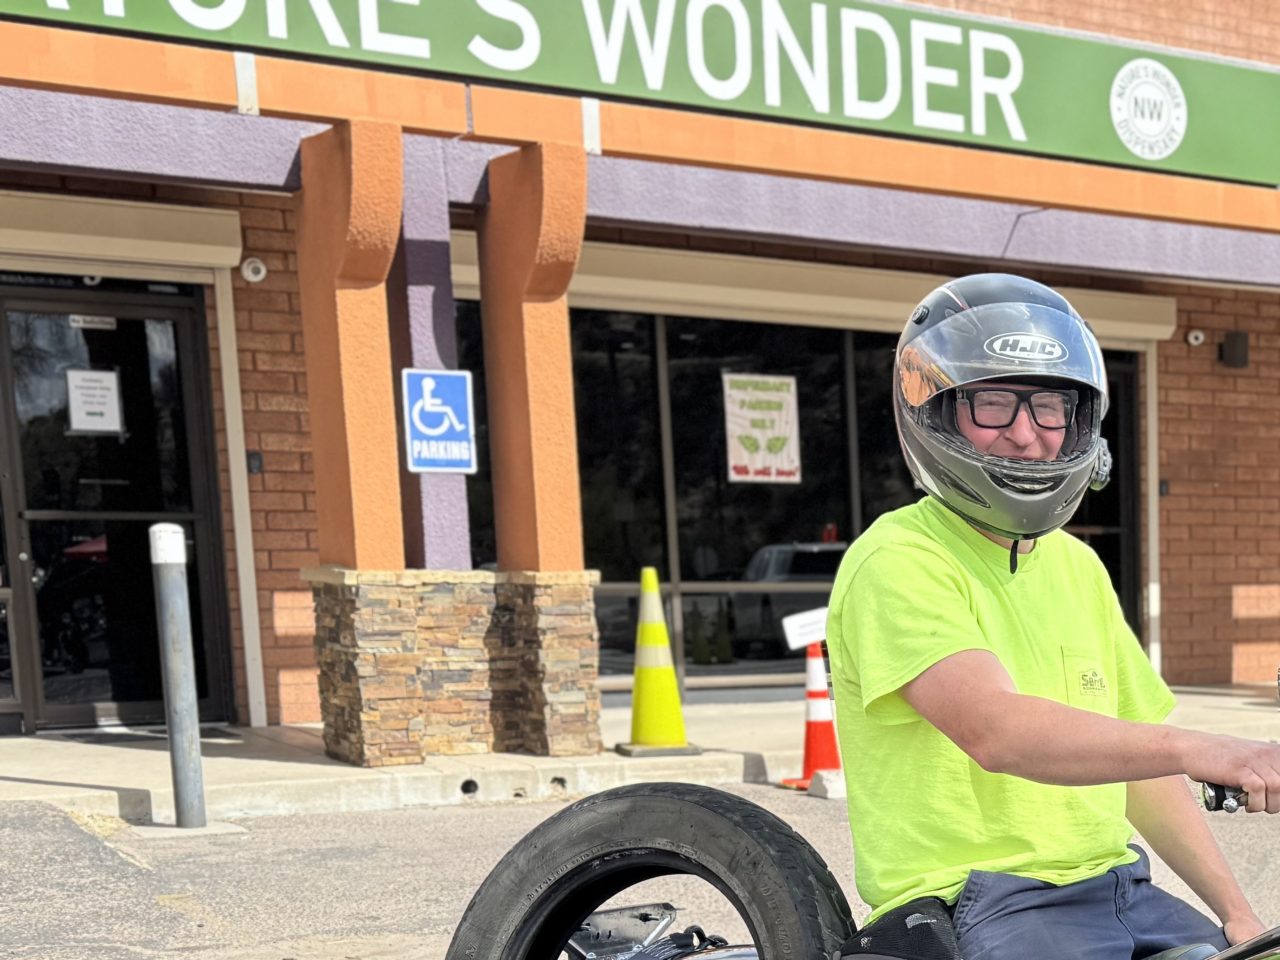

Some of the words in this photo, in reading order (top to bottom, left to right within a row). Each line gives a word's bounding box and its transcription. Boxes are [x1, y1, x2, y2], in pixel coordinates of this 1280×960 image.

[581, 0, 1028, 142] WONDER
[1134, 96, 1164, 122] NW
[999, 338, 1057, 356] HJC
[412, 439, 470, 461] PARKING
